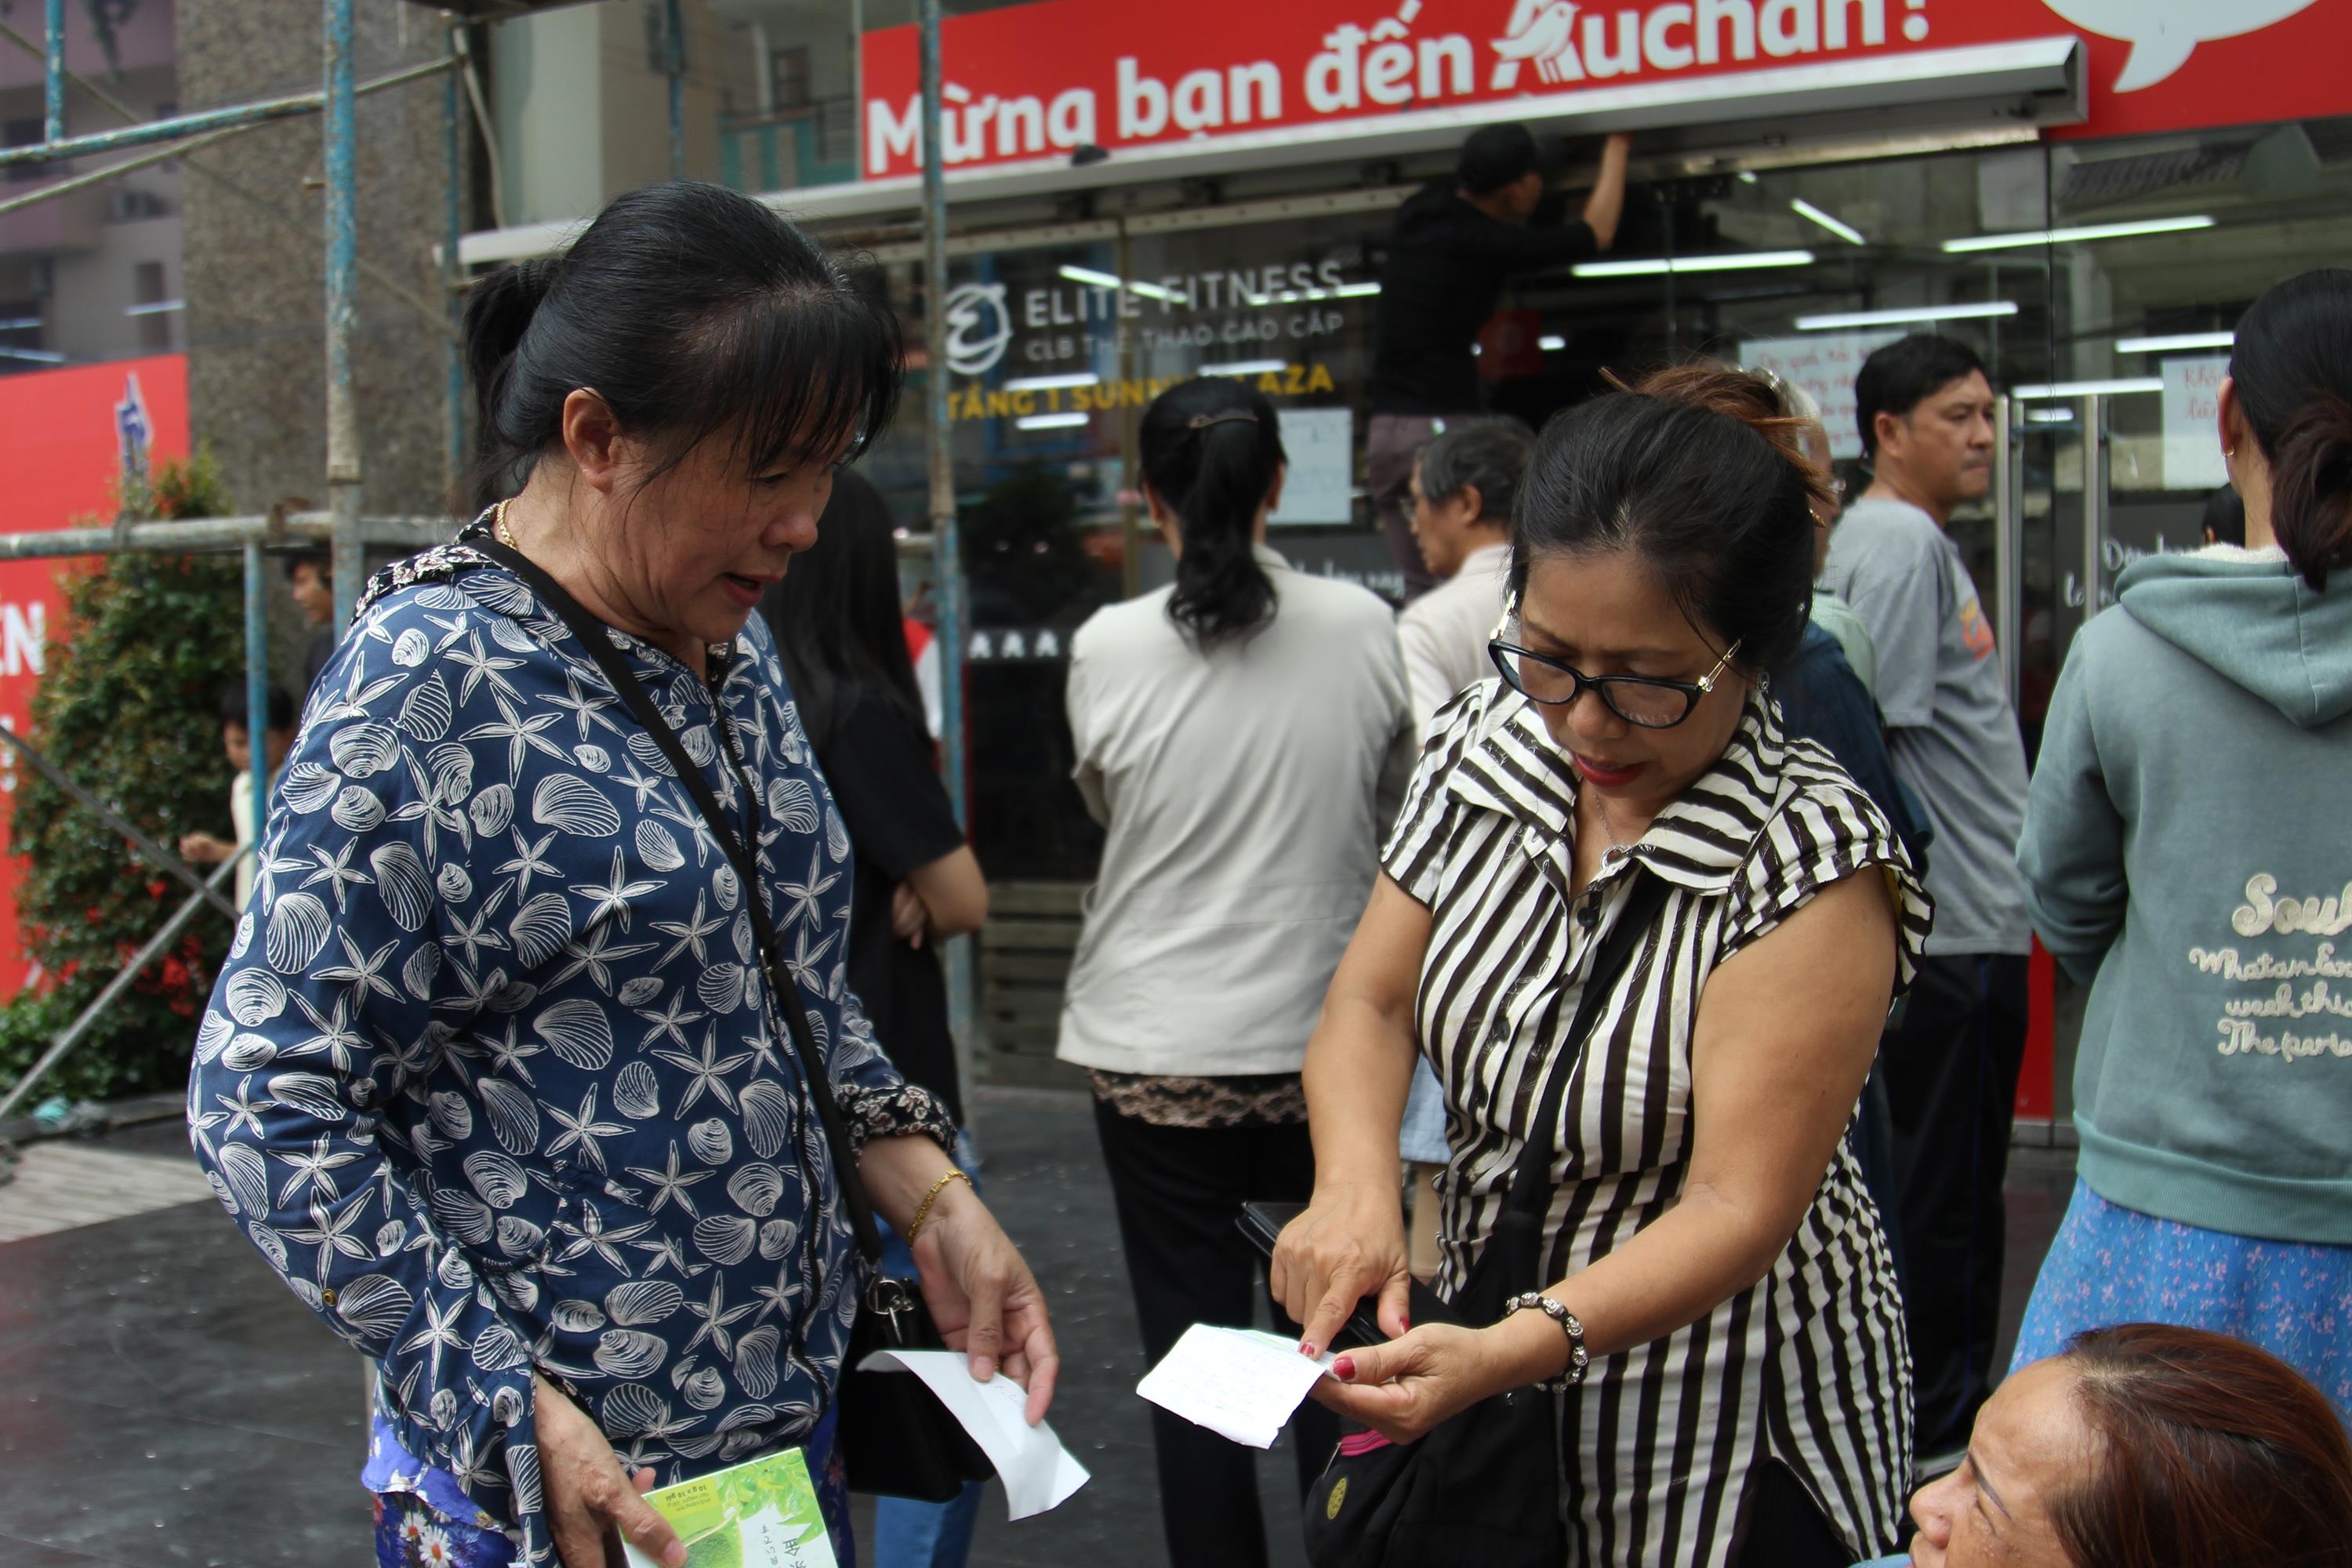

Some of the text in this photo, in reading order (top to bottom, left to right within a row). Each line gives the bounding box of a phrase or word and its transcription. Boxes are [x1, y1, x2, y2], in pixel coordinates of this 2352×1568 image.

[1117, 55, 1282, 143] bạn
[1304, 0, 1474, 114] đến
[1025, 259, 1344, 328] ELITE FITNESS
[1025, 336, 1075, 361] CLB
[1140, 321, 1214, 350] THAO
[1221, 316, 1279, 344] CAO
